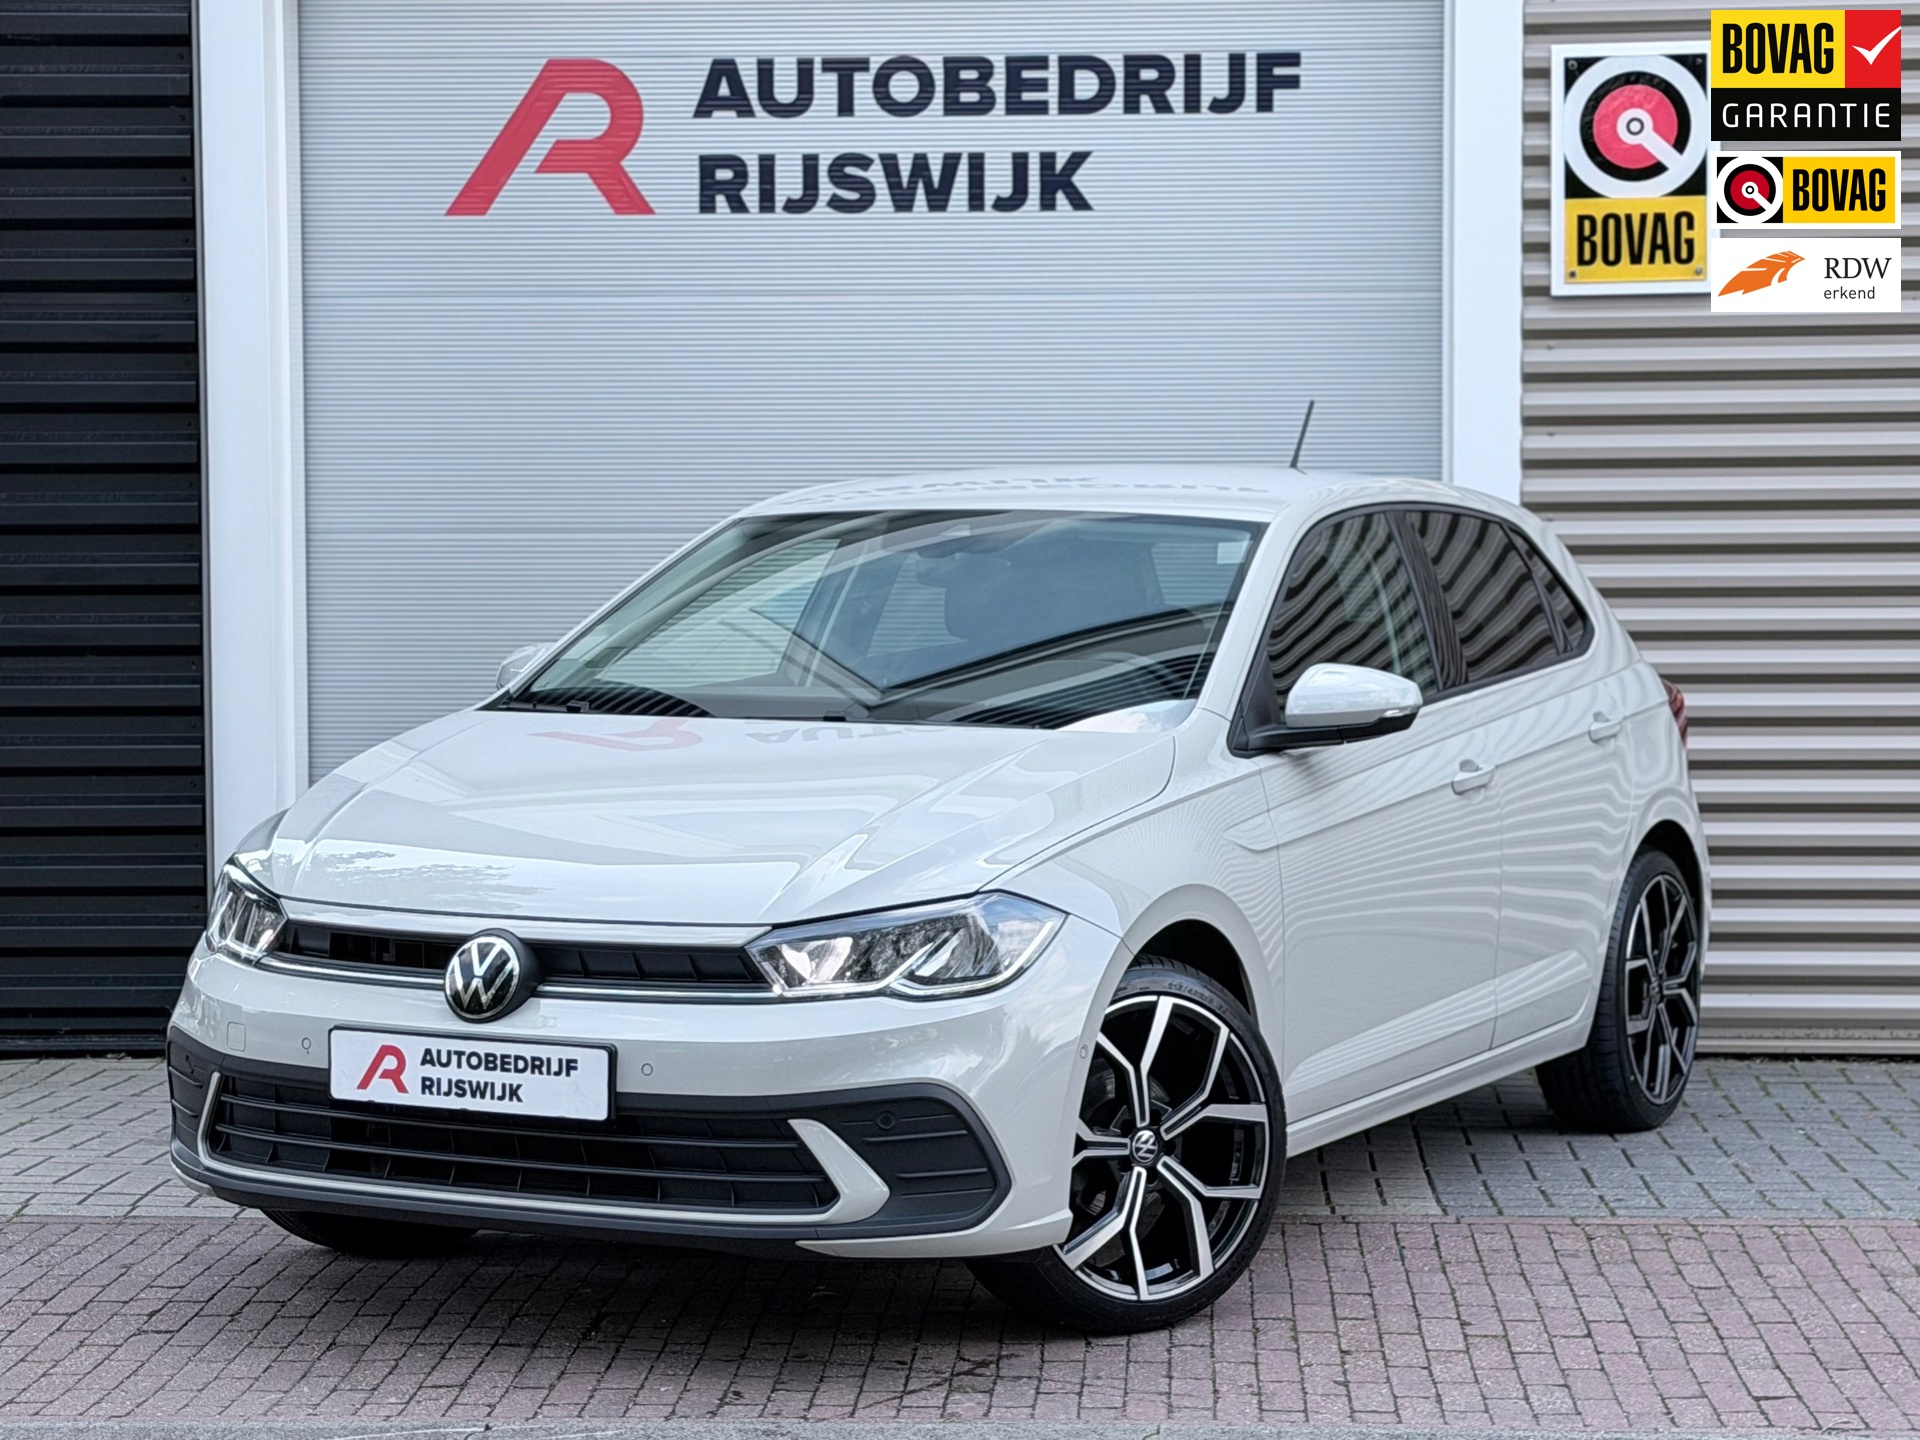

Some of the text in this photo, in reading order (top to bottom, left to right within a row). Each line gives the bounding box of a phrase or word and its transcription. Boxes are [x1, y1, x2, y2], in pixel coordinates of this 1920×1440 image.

[694, 52, 1301, 118] AUTOBEDRIJF
[698, 151, 1093, 214] RIJSWIJK
[1577, 211, 1696, 267] BOVAG
[420, 1047, 579, 1078] AUTOBEDRIJF
[420, 1076, 524, 1103] RIJSWIJK
